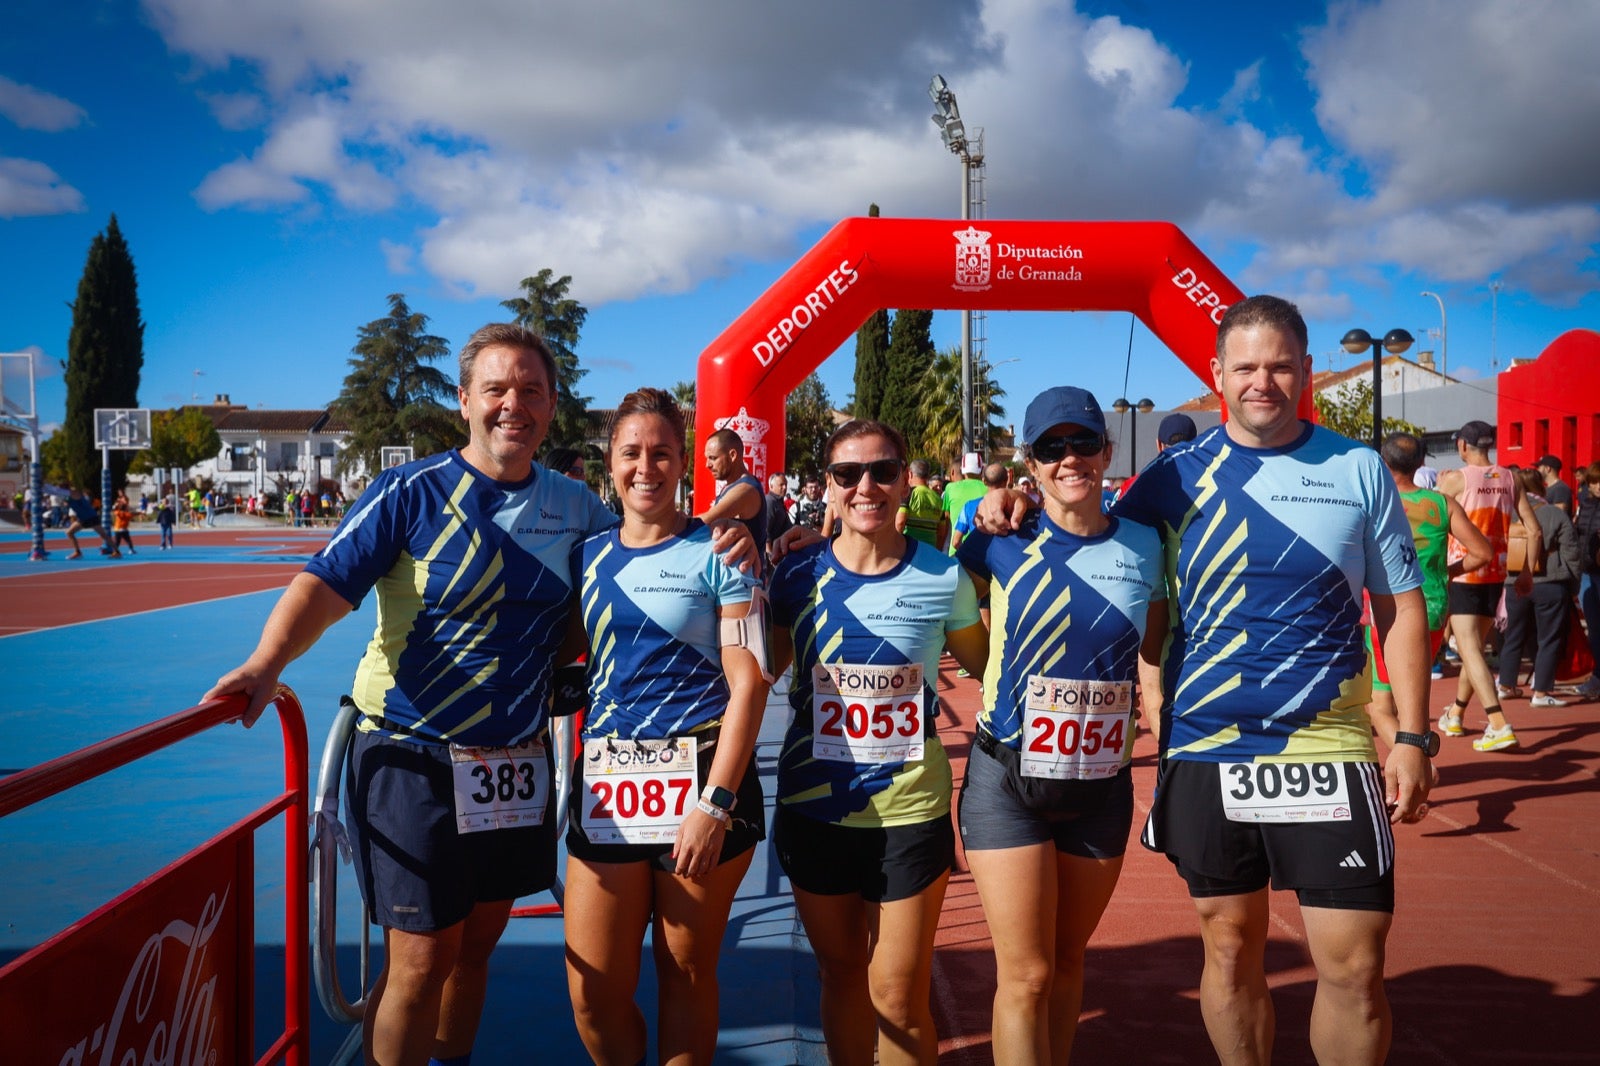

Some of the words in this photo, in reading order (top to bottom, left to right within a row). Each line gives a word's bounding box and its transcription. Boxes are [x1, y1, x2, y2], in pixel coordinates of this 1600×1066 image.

[997, 243, 1083, 261] Diputación
[997, 265, 1014, 280] de
[1019, 265, 1082, 281] Granada
[752, 260, 859, 367] DEPORTES
[838, 673, 904, 690] FONDO
[1054, 688, 1116, 706] FONDO
[820, 701, 920, 739] 2053
[1028, 716, 1124, 756] 2054
[471, 762, 536, 804] 383
[589, 778, 693, 819] 2087
[1228, 762, 1339, 801] 3099
